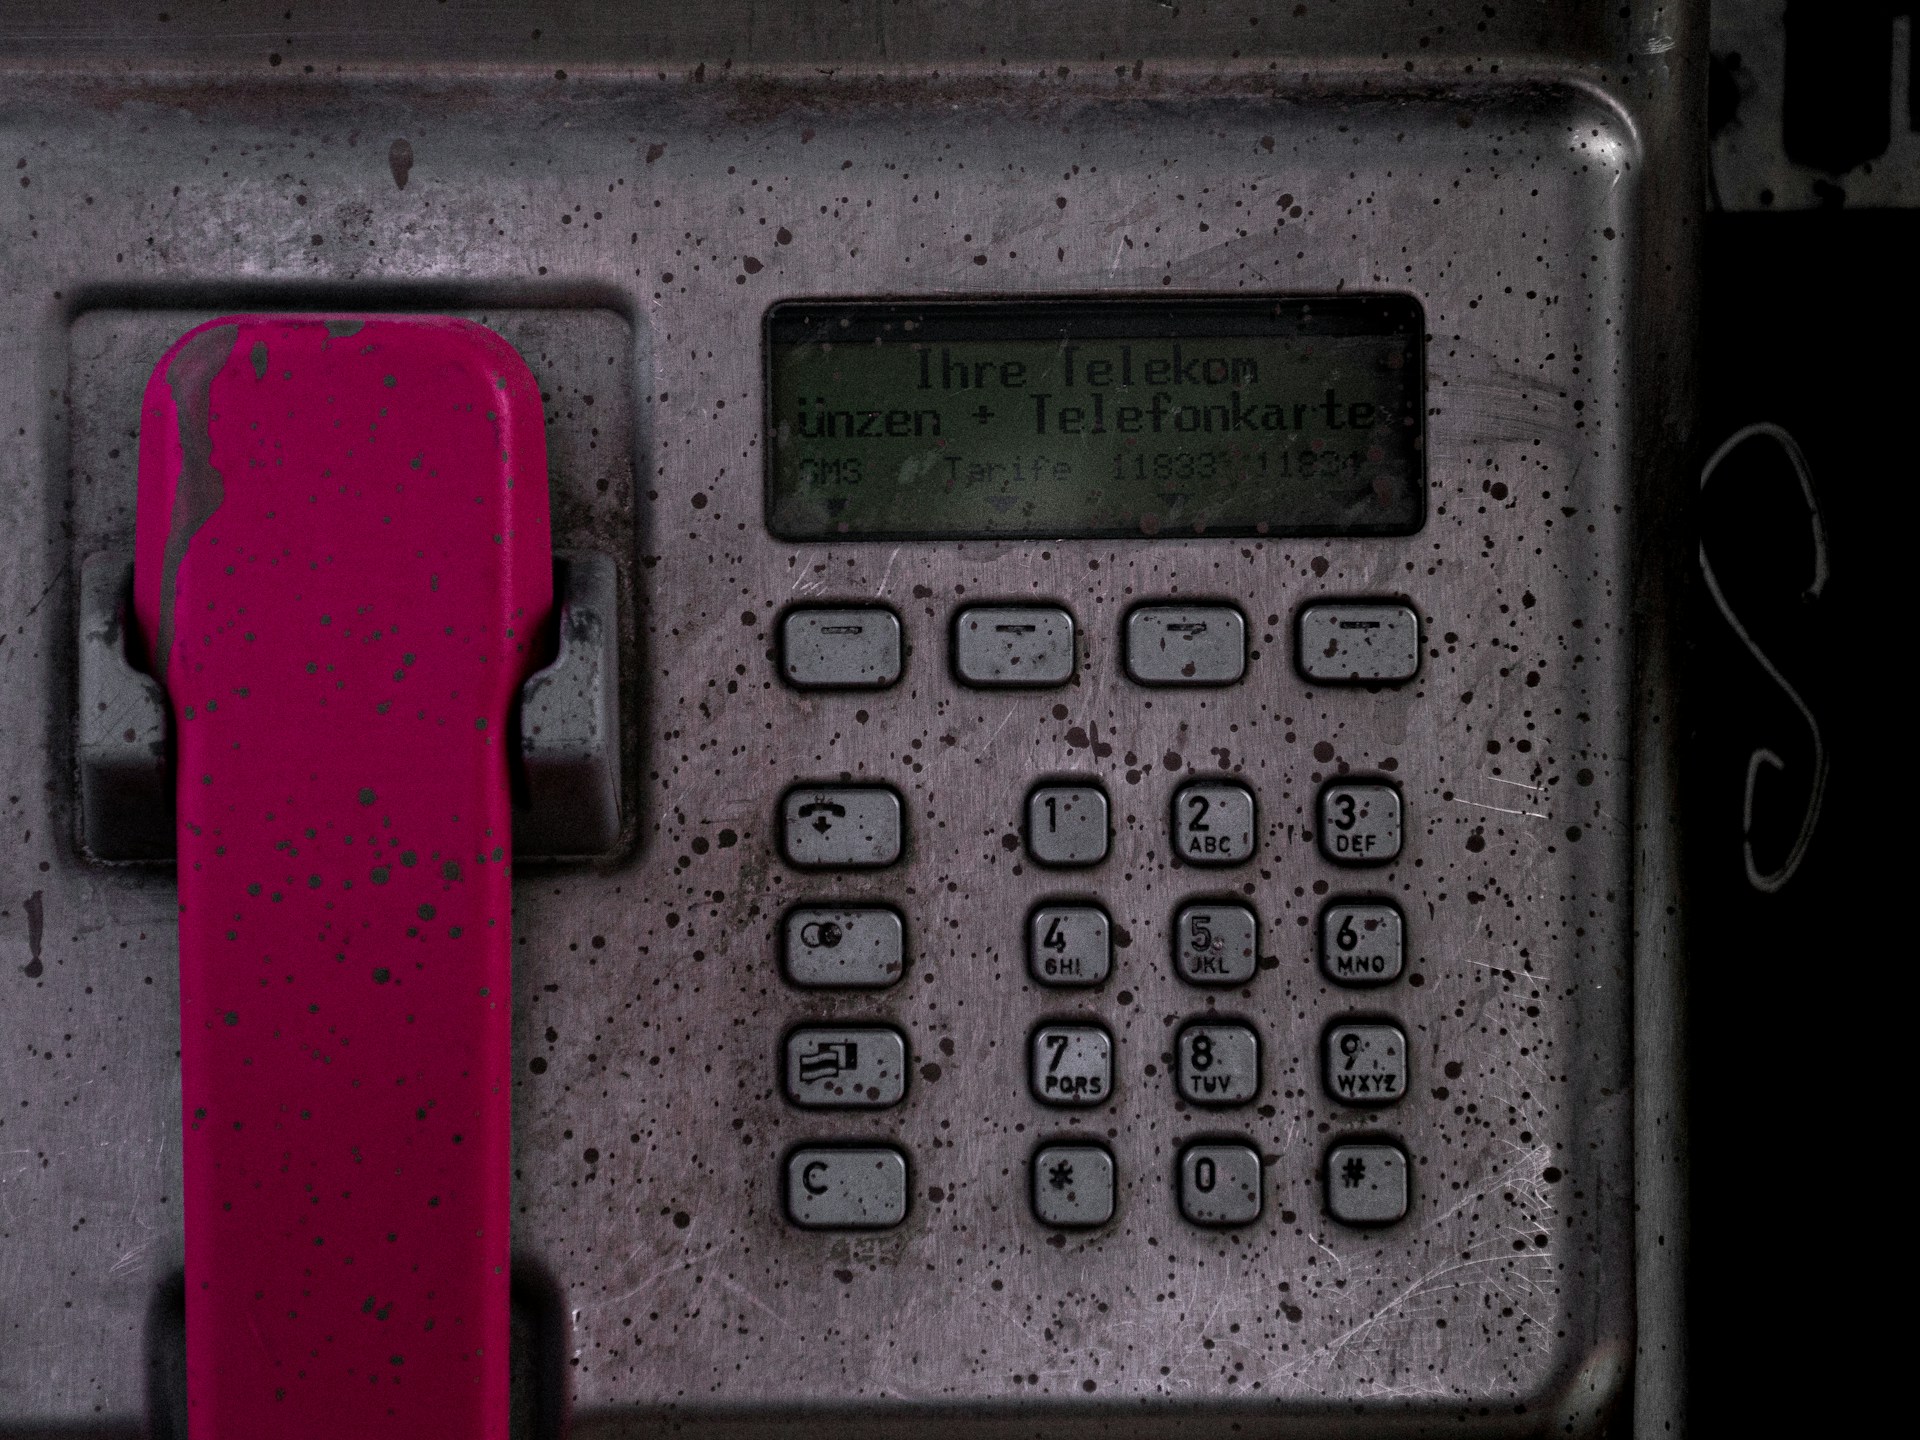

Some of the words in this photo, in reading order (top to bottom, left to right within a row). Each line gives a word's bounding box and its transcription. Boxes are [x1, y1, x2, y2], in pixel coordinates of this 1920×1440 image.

[917, 347, 1027, 390] Ihre
[1063, 344, 1259, 387] Telekom
[797, 397, 942, 439] ünzen
[972, 404, 995, 425] +
[1030, 388, 1376, 435] Telefonkarte
[799, 457, 862, 485] SMS
[943, 455, 1071, 483] Tarife
[1044, 797, 1056, 833] 1
[1188, 795, 1210, 832] 2
[1334, 794, 1356, 831] 3
[1189, 836, 1231, 853] ABC
[1336, 835, 1376, 853] DEF
[1043, 917, 1066, 951] 4
[1190, 915, 1212, 951] 5
[1336, 915, 1358, 951] 6
[1045, 957, 1081, 975] GHI
[1191, 956, 1229, 974] JKL
[1337, 955, 1386, 973] MNO
[1046, 1035, 1069, 1072] 7
[1191, 1035, 1213, 1071] 8
[1340, 1033, 1361, 1071] 9
[1045, 1076, 1101, 1095] PQRS
[1190, 1075, 1231, 1093] TUV
[1337, 1073, 1396, 1093] WXYZ
[802, 1160, 828, 1195] C
[1195, 1157, 1216, 1193] 0
[1342, 1158, 1366, 1188] #
